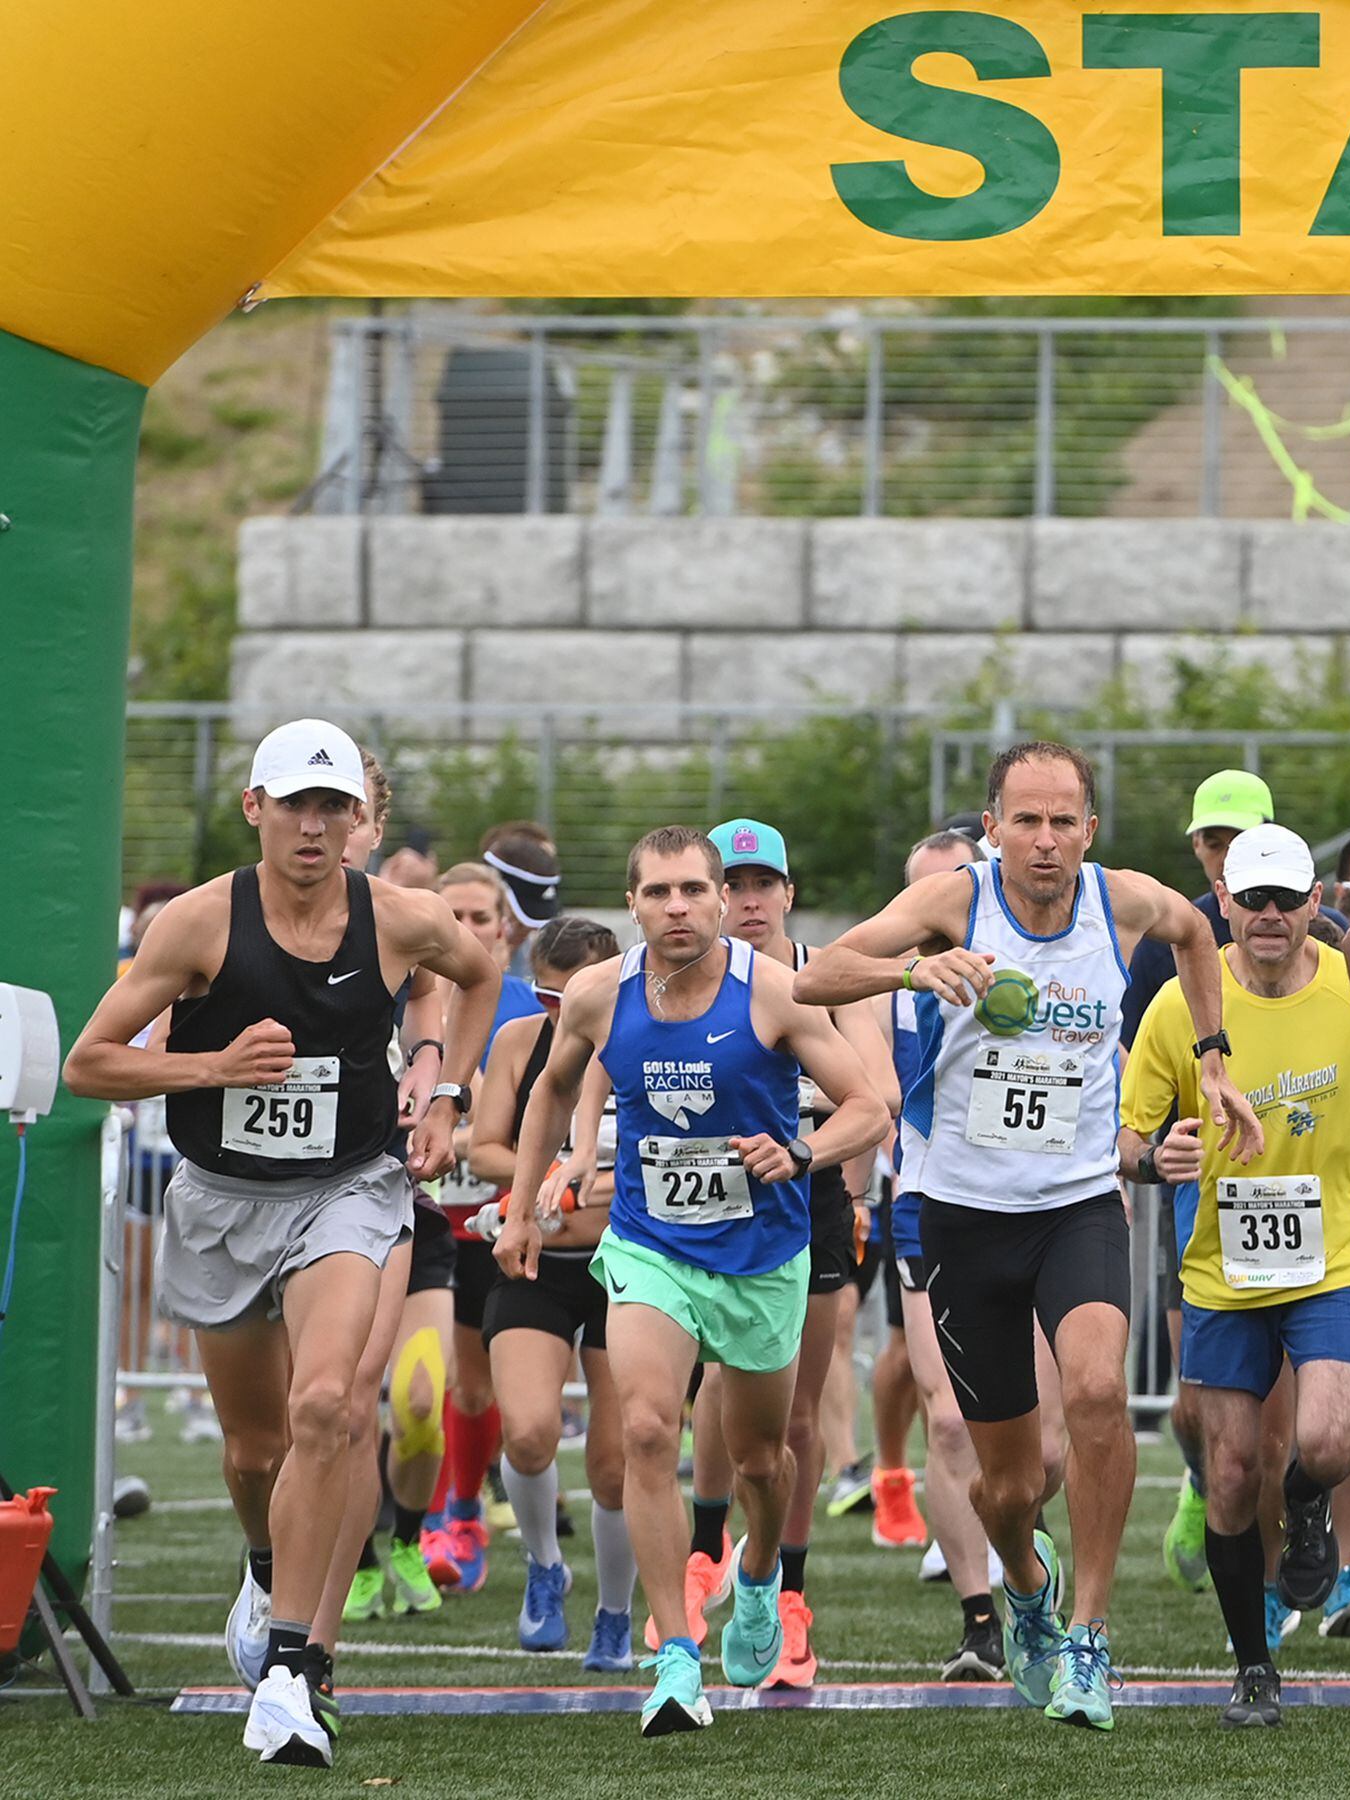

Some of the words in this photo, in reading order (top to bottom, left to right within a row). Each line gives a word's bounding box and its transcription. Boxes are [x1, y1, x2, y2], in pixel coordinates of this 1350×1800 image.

[1047, 981, 1087, 1002] Run
[679, 1061, 712, 1074] Louis
[644, 1075, 714, 1090] RACING
[990, 1071, 1005, 1080] 2021
[1007, 1073, 1034, 1083] MAYOR'S
[1035, 1076, 1067, 1086] MARATHON
[286, 1083, 321, 1092] MARATHON
[649, 1093, 713, 1103] TEAM
[243, 1094, 313, 1138] 259
[1003, 1087, 1048, 1130] 55
[696, 1158, 729, 1166] MARATHON
[662, 1171, 728, 1206] 224
[1233, 1202, 1247, 1210] 2021
[1248, 1201, 1273, 1209] MAYOR'S
[1274, 1200, 1306, 1208] MARATHON
[1240, 1213, 1303, 1251] 339
[1228, 1273, 1276, 1284] SUBWAY
